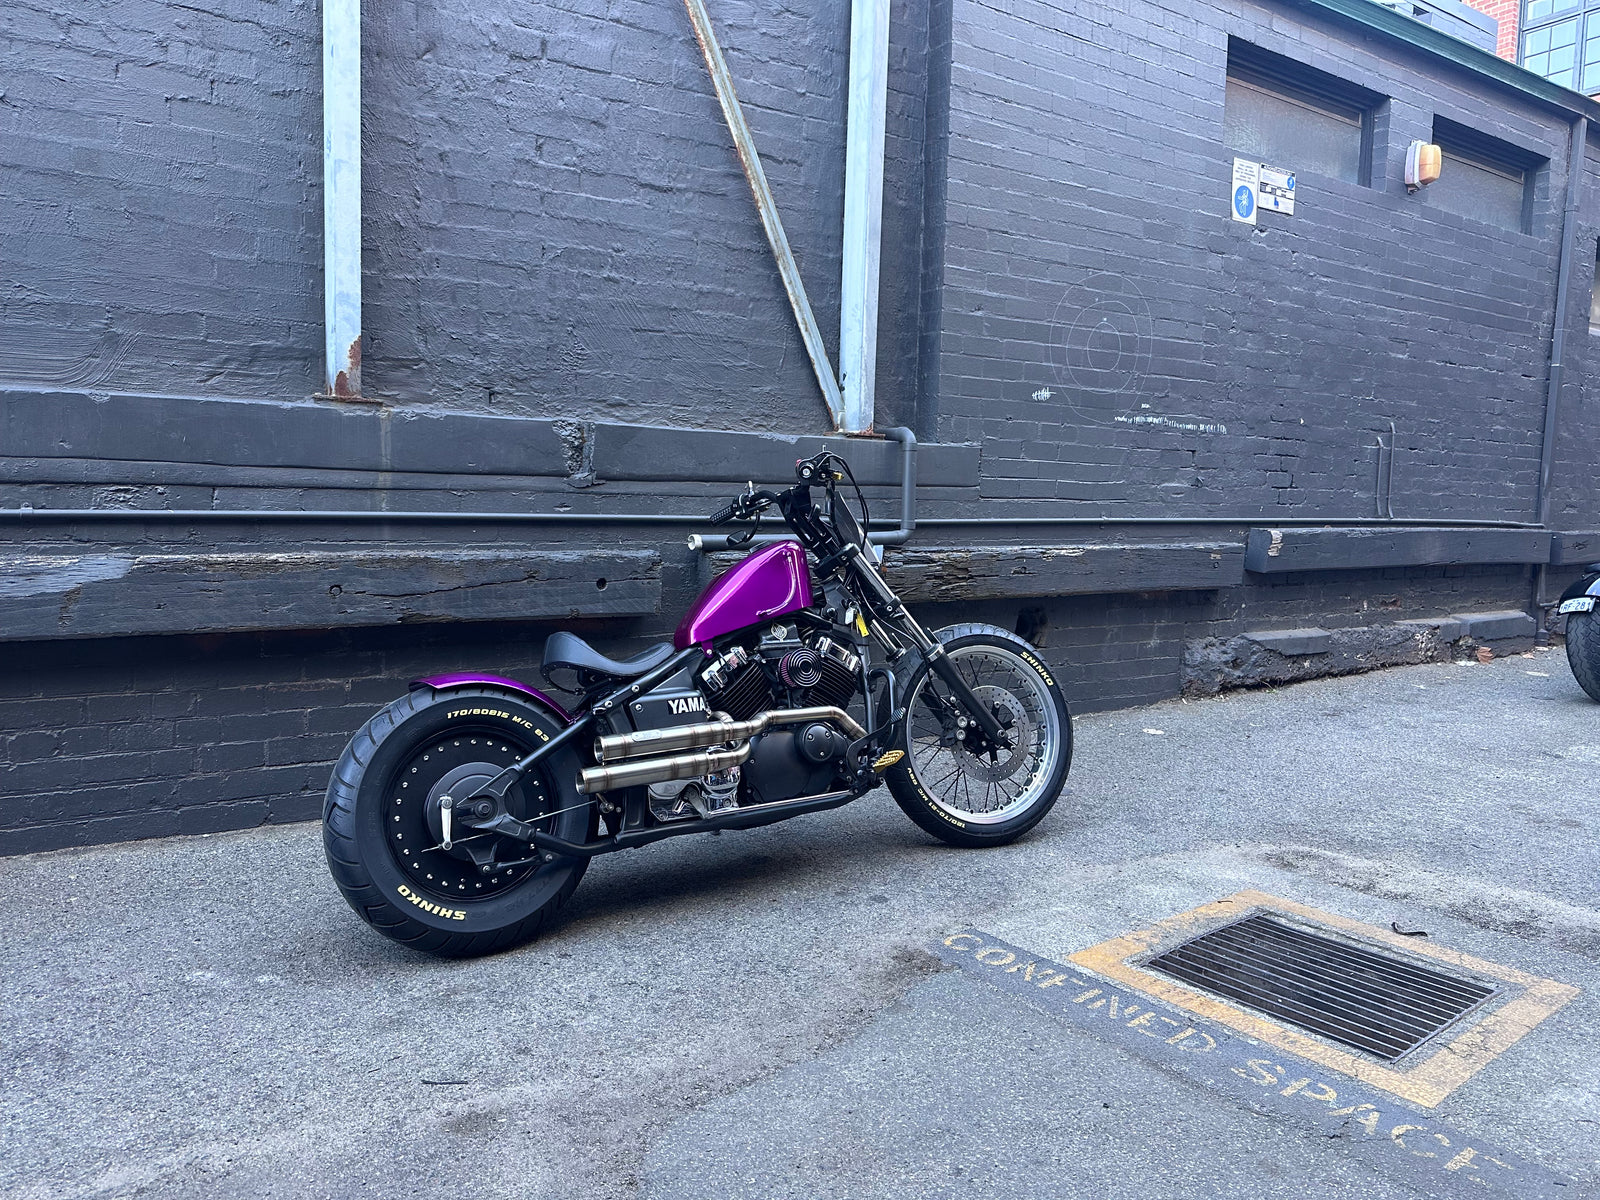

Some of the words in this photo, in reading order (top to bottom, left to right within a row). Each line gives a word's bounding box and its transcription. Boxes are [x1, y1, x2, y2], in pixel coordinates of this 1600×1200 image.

[1020, 651, 1054, 687] SHINKO
[511, 715, 534, 730] M/C
[397, 884, 468, 921] SHINKO
[942, 932, 1219, 1055] CONFINED
[1230, 1059, 1514, 1187] SPACE
